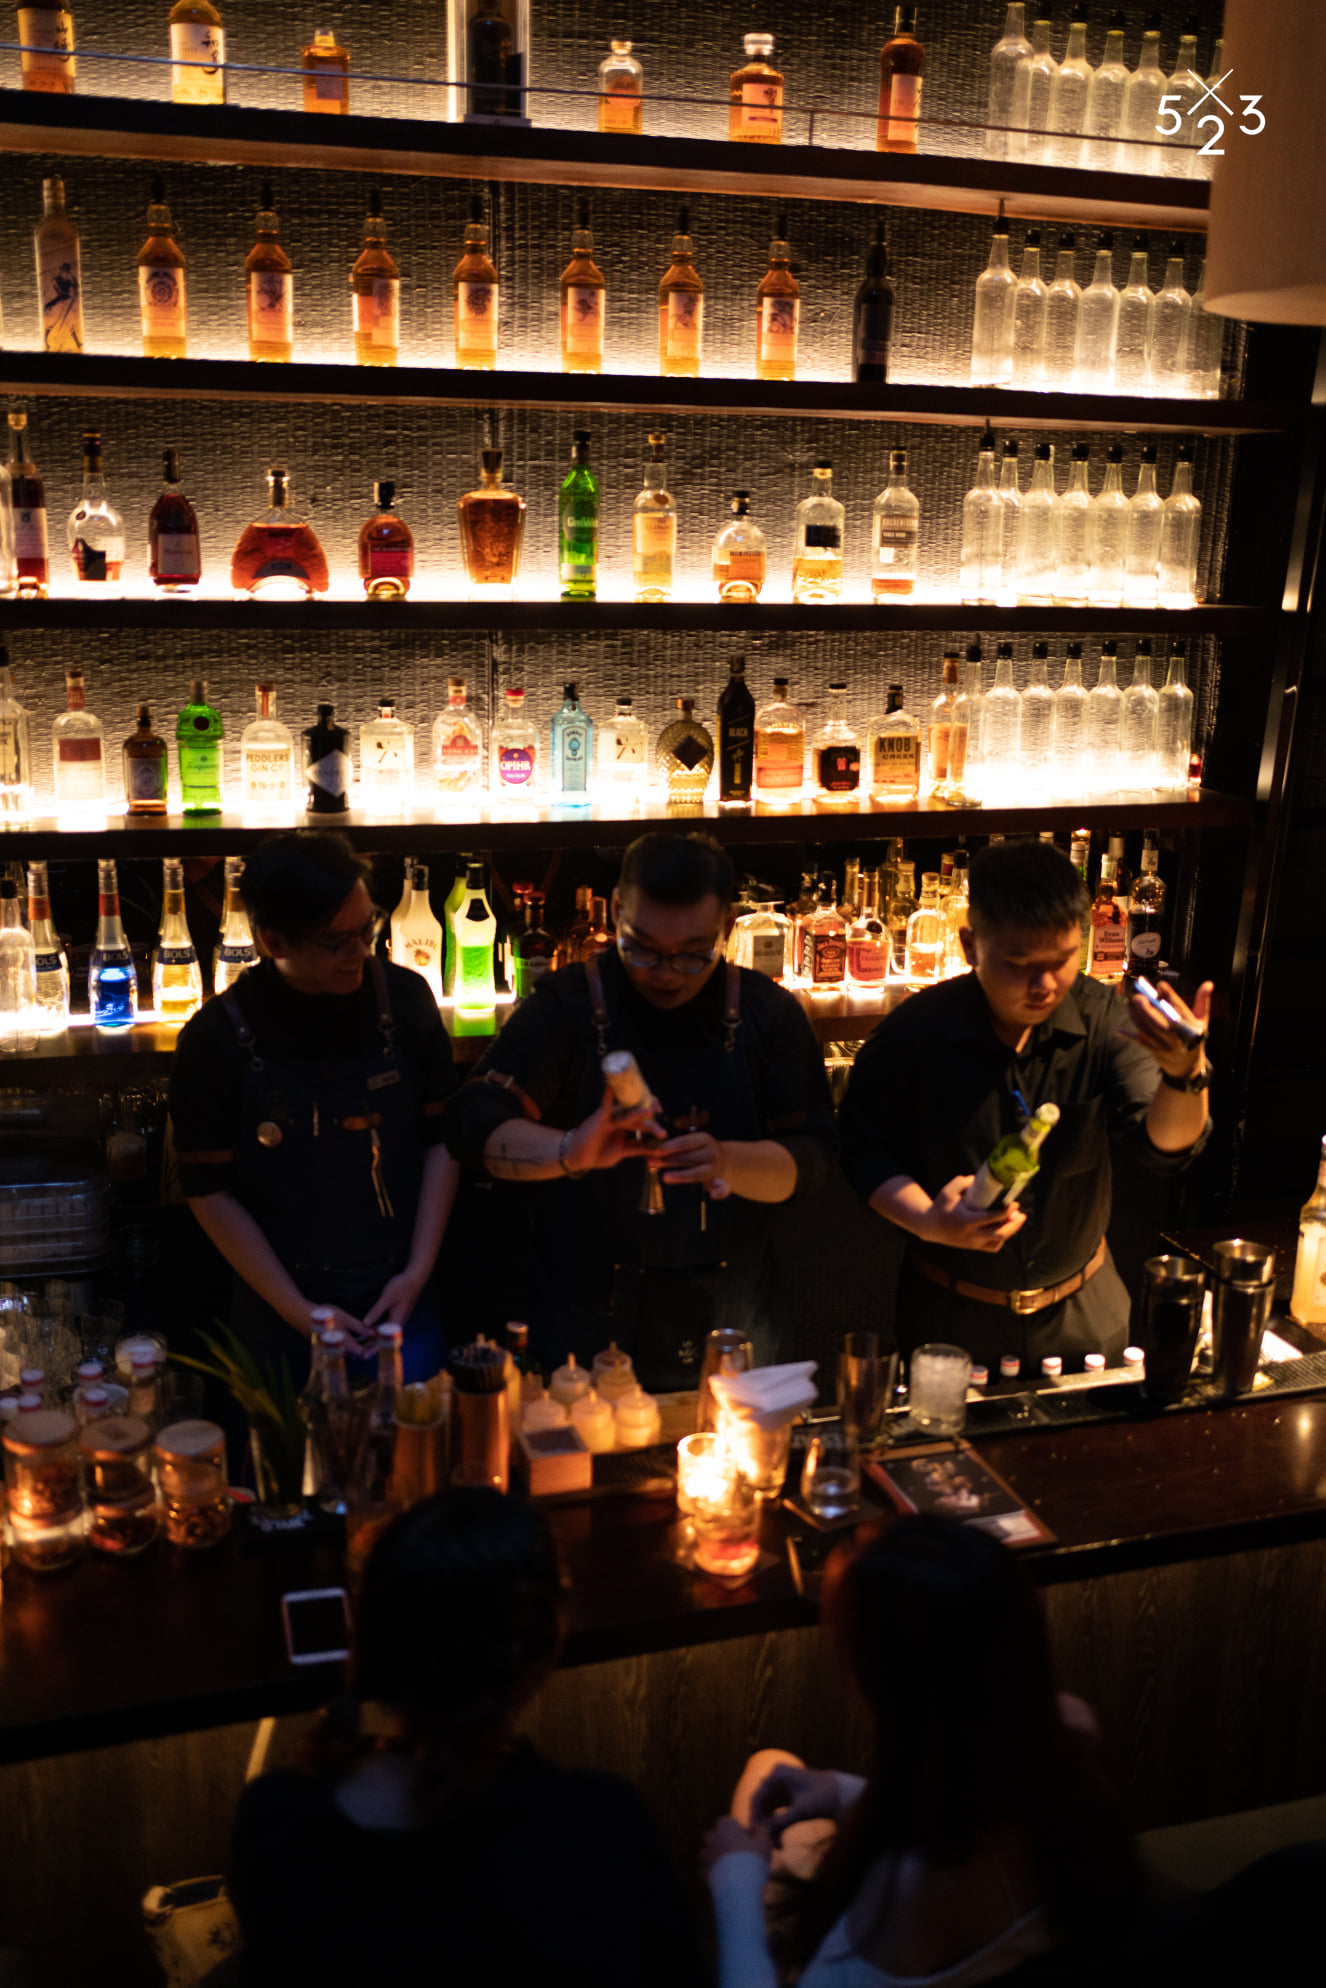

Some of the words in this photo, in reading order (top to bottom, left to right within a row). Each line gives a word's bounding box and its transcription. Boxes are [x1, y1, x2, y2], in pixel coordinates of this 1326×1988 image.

[879, 737, 911, 752] KNOB
[246, 753, 289, 762] PEDDLERS
[102, 950, 129, 962] BOLS
[163, 950, 191, 960] BOLS
[36, 956, 57, 966] OLS
